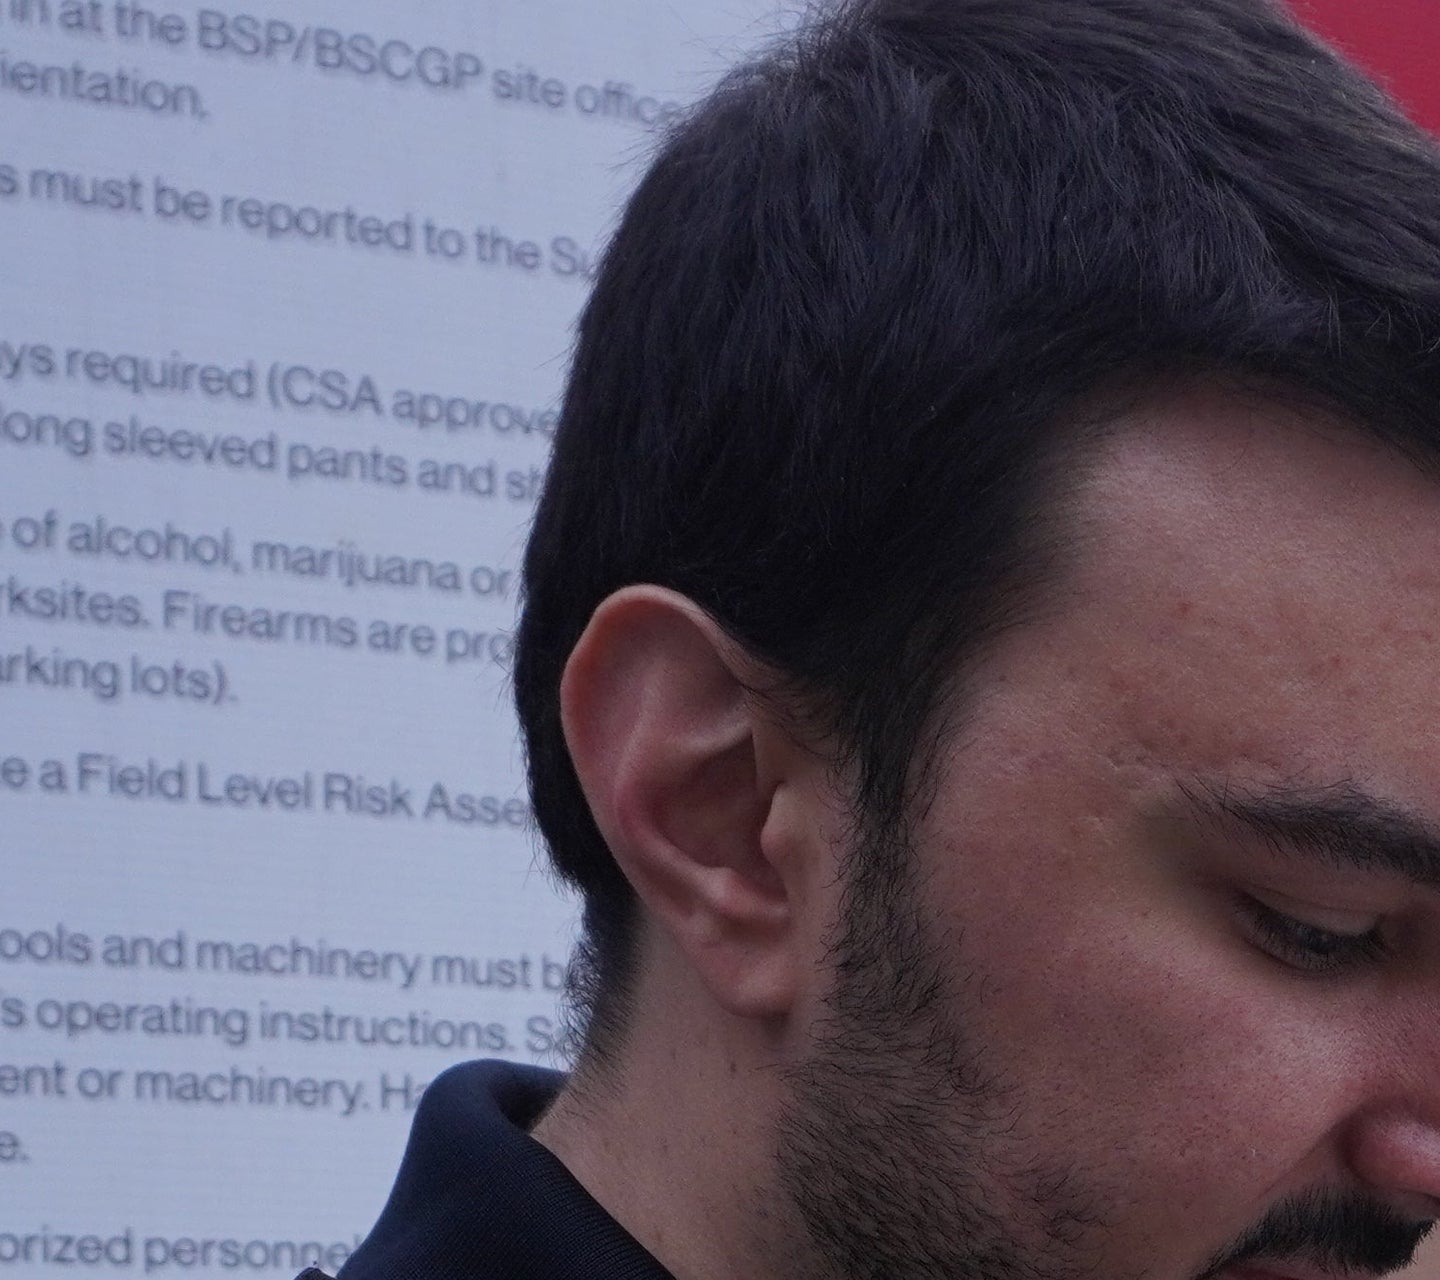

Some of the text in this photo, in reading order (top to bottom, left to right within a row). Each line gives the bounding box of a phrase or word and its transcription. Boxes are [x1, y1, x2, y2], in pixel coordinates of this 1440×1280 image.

[113, 0, 188, 47] the
[196, 8, 485, 91] BSP/BSCGP
[492, 69, 567, 111] site
[28, 169, 144, 215] must
[152, 180, 213, 225] be
[220, 195, 415, 254] reported
[422, 220, 467, 261] to
[473, 229, 543, 274] the
[64, 348, 258, 403] required
[265, 364, 385, 417] (CSA
[103, 418, 279, 473] sleeved
[286, 443, 410, 489] pants
[416, 459, 498, 499] and
[10, 509, 59, 552] of
[66, 518, 242, 574] alcohol,
[251, 540, 464, 594] marijuana
[161, 588, 361, 650] Firearms
[366, 620, 438, 658] are
[37, 759, 69, 794] a
[76, 751, 189, 803] Field
[196, 763, 315, 812] Level
[321, 771, 414, 819] Risk
[100, 931, 188, 972] and
[194, 938, 423, 992] machinery
[430, 954, 533, 992] must
[34, 998, 252, 1050] operating
[258, 1007, 517, 1052] instructions.
[75, 1067, 124, 1102] or
[133, 1067, 370, 1118] machinery.
